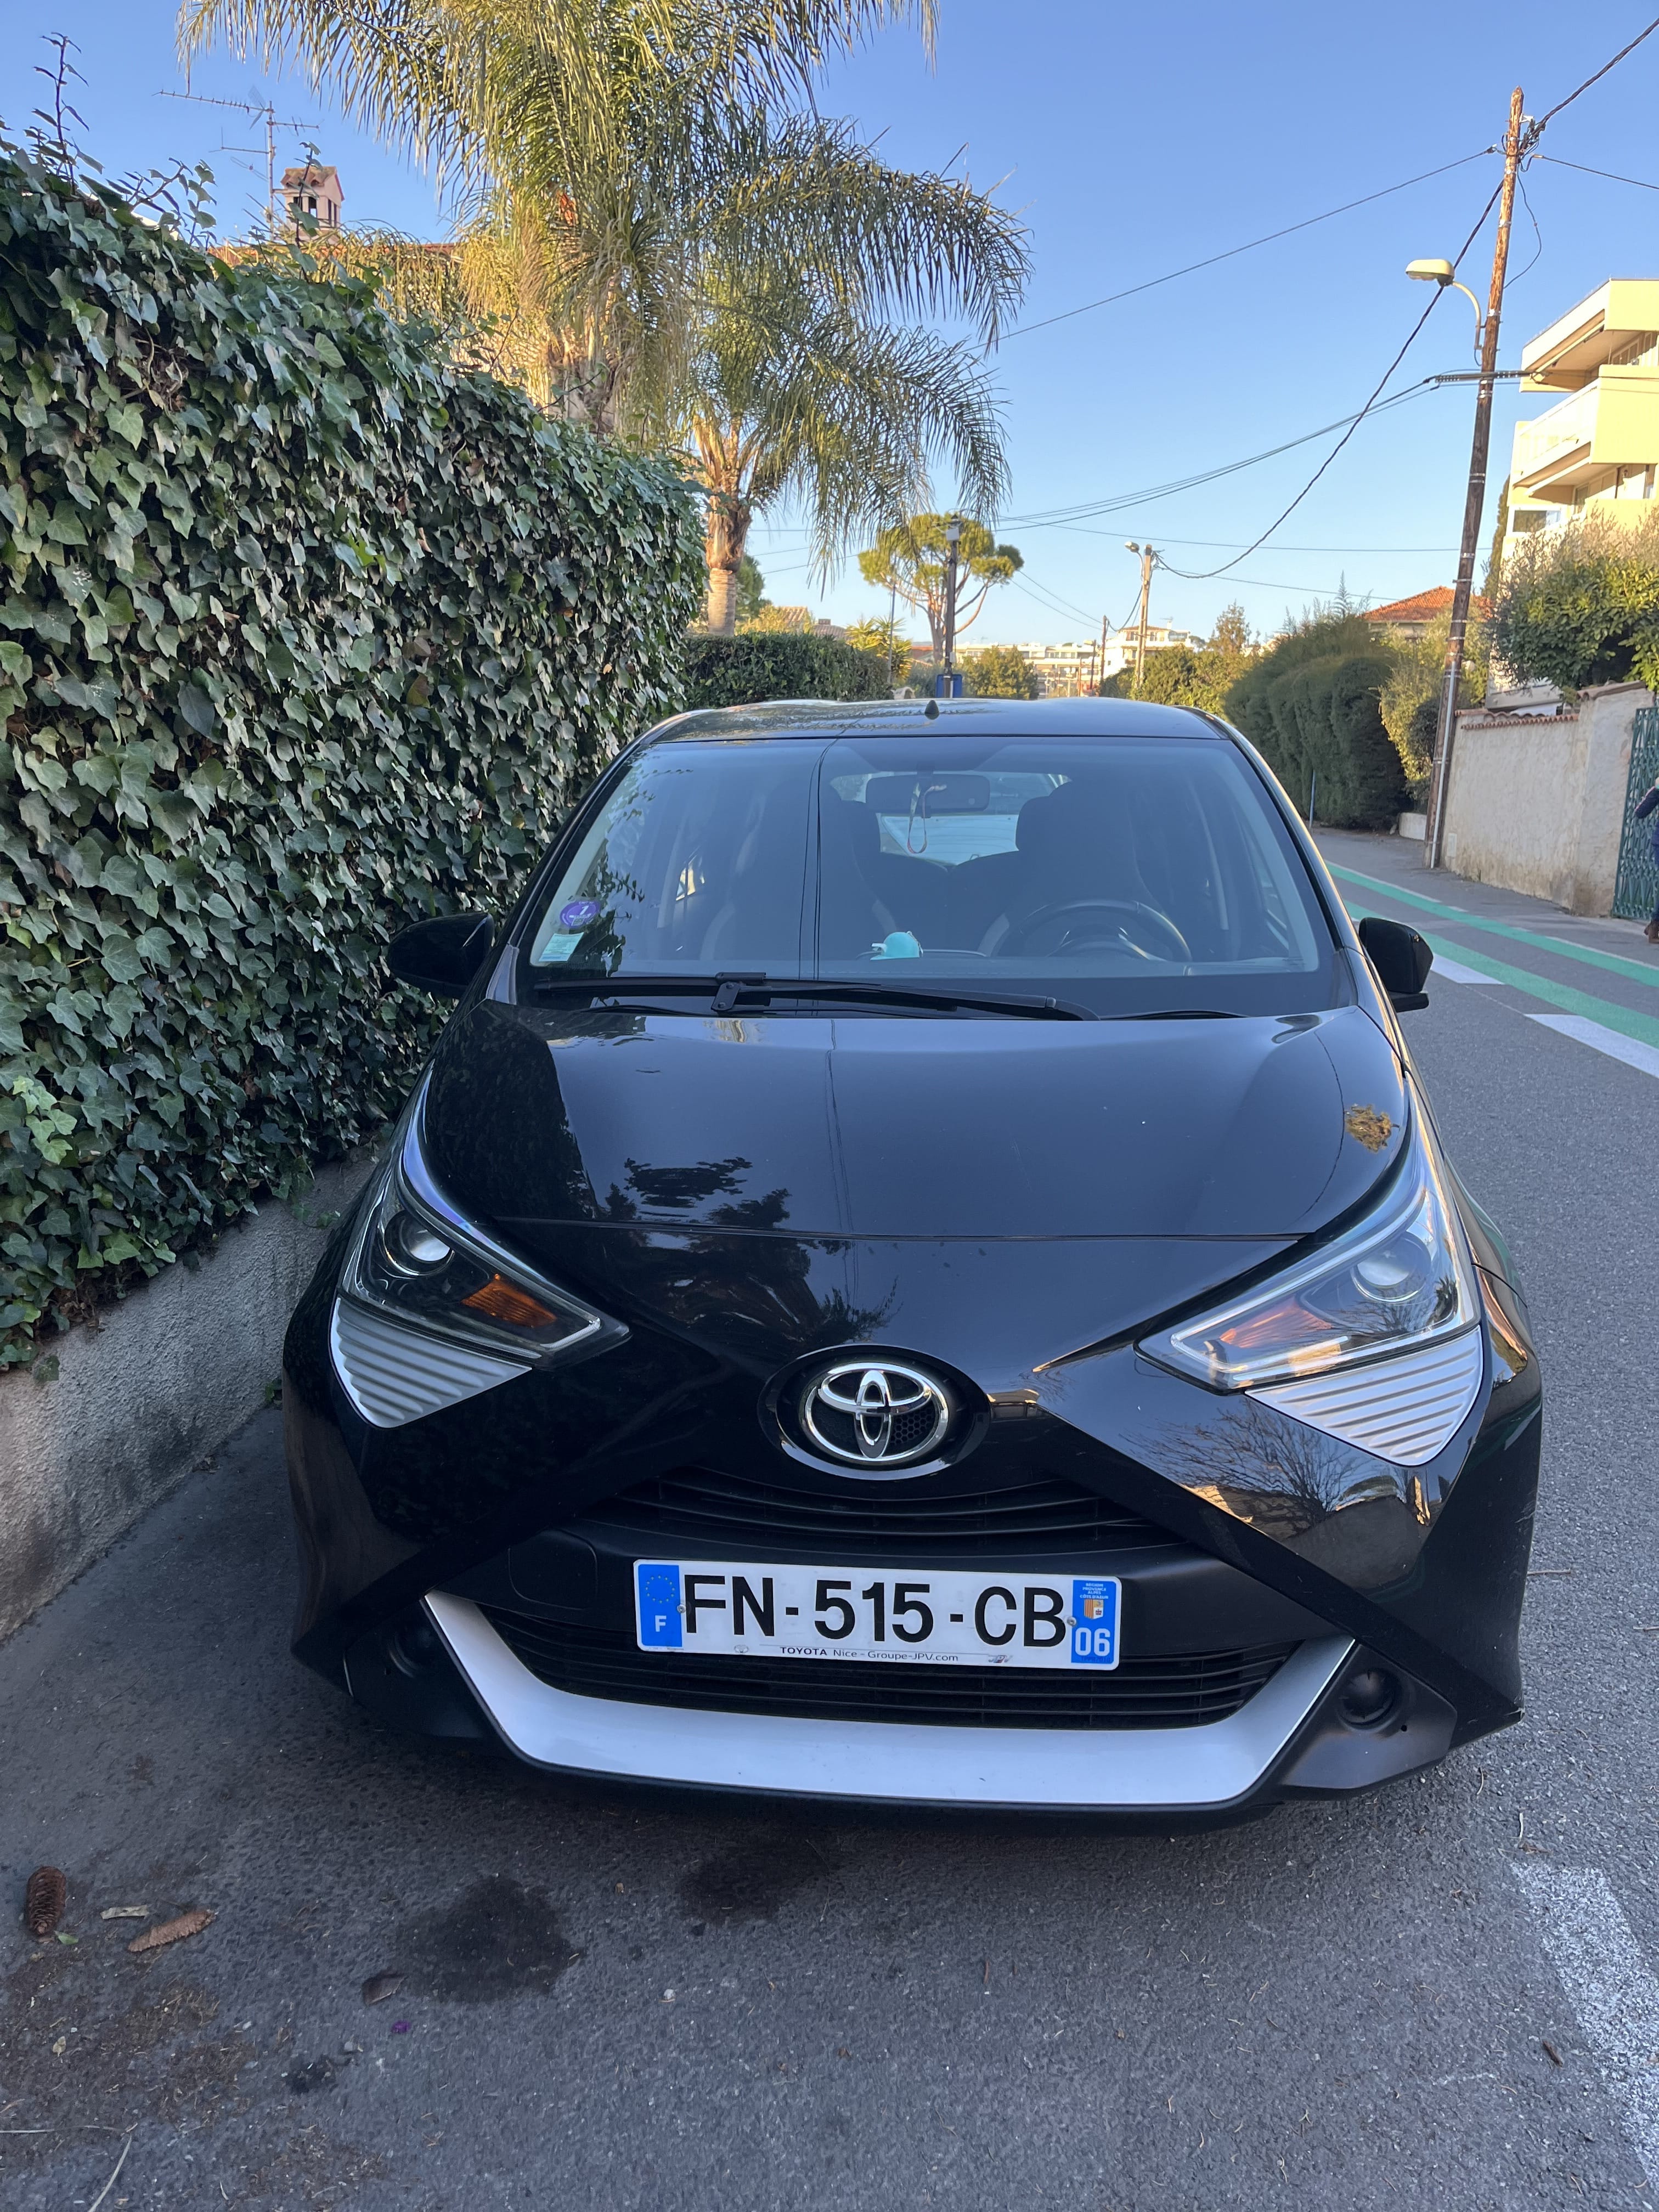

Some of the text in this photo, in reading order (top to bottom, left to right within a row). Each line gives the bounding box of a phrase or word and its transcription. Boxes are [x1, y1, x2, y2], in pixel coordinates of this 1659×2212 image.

[684, 1575, 1066, 1647] FN-515-CB
[654, 1615, 667, 1633] F
[1075, 1627, 1110, 1656] 06
[780, 1646, 827, 1656] TOYOTA
[833, 1649, 857, 1657] Nice
[867, 1651, 958, 1662] Groupe-JPV.com
